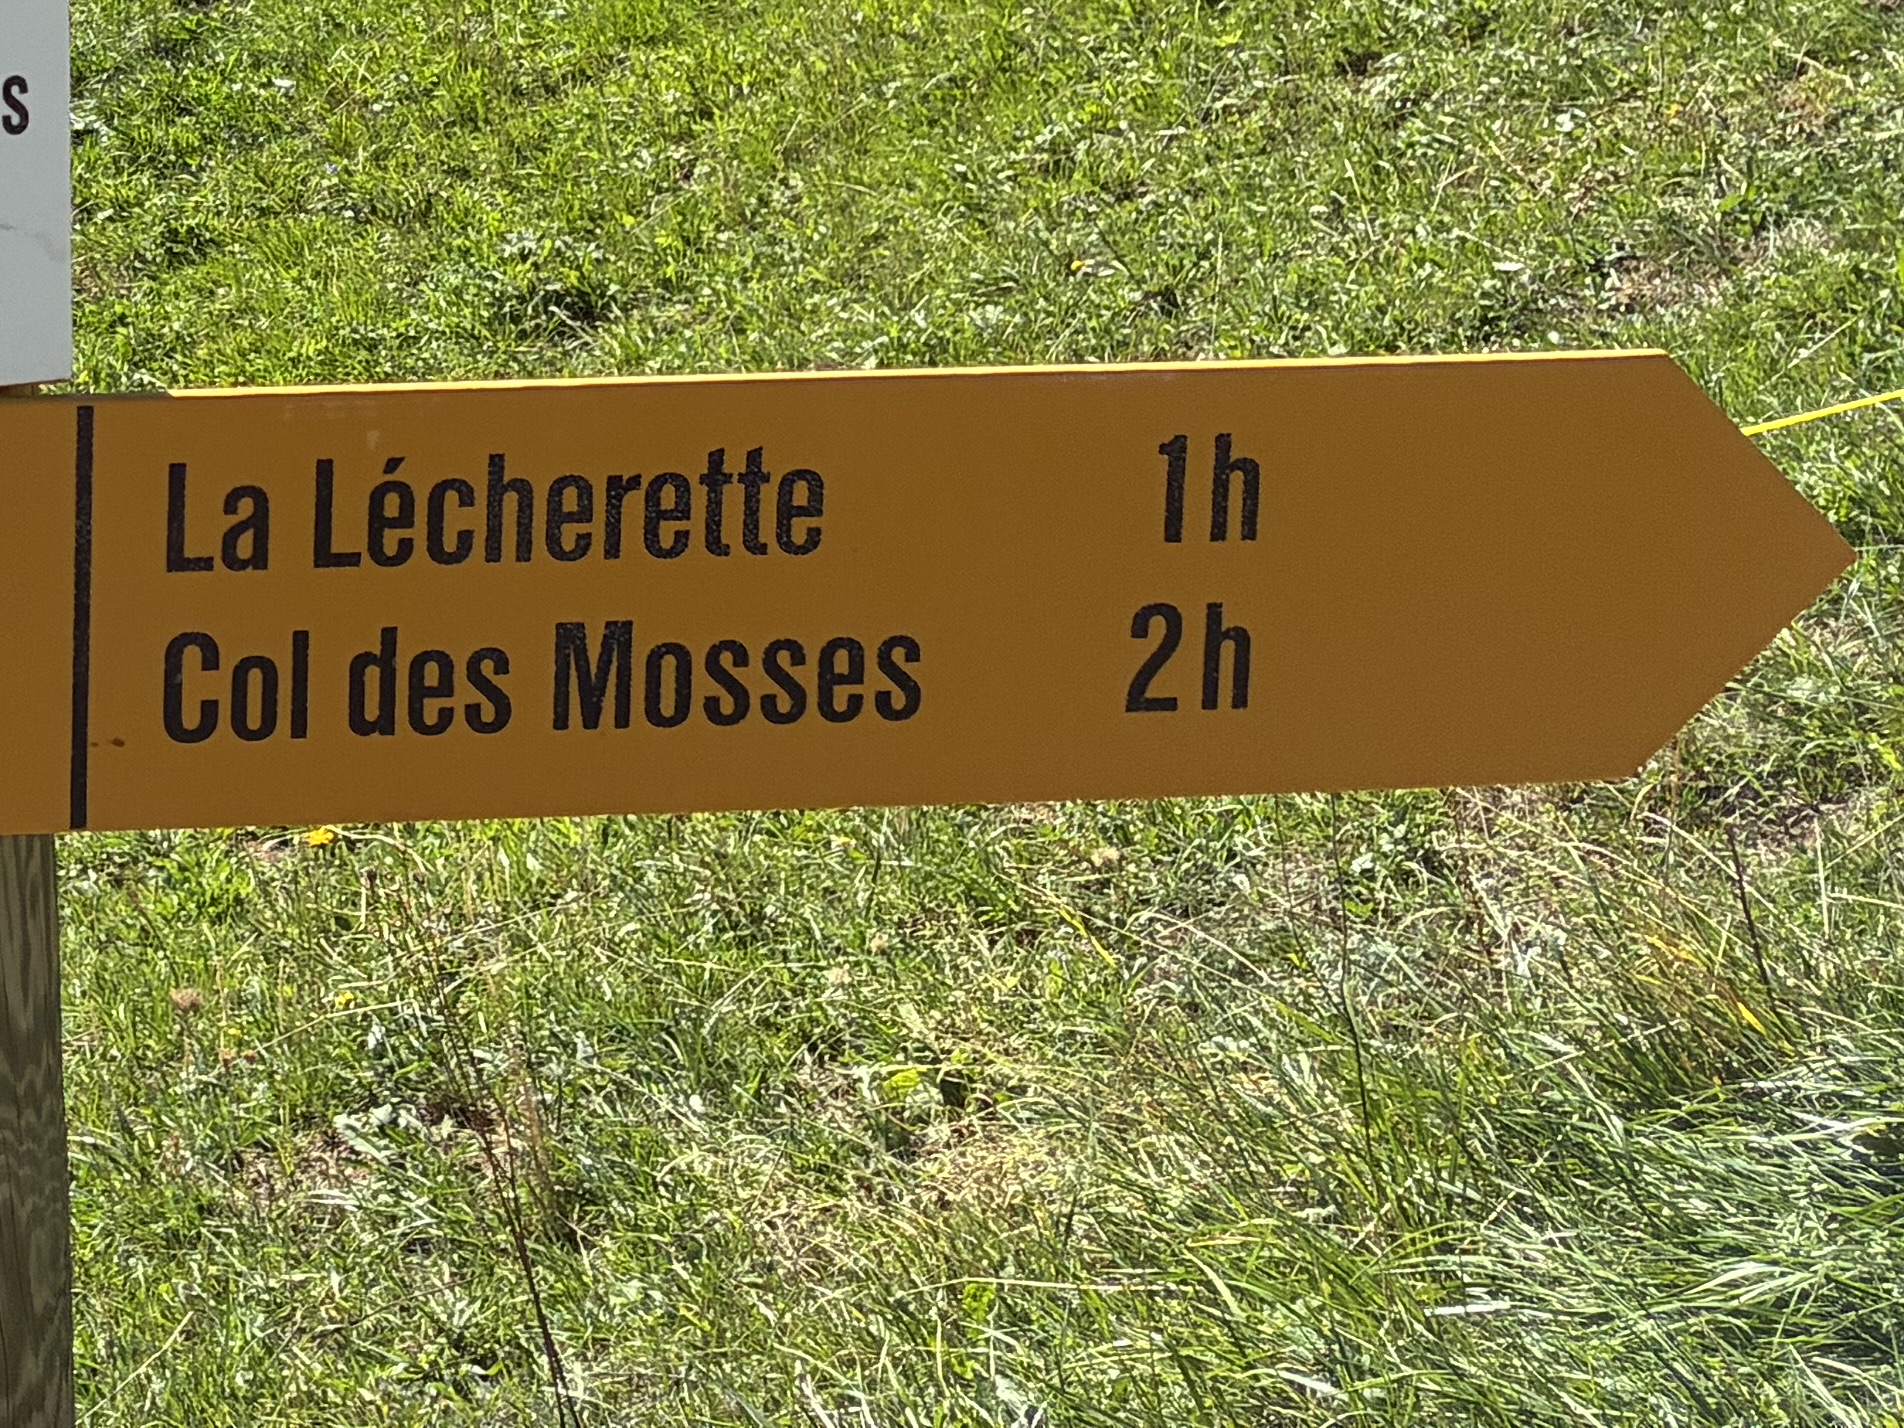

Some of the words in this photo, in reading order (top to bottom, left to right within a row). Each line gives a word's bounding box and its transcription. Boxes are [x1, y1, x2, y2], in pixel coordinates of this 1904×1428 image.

[164, 460, 272, 575] La
[311, 444, 827, 570] Lécherette
[161, 628, 312, 746] Col
[346, 624, 514, 739] des
[551, 618, 923, 733] Mosses
